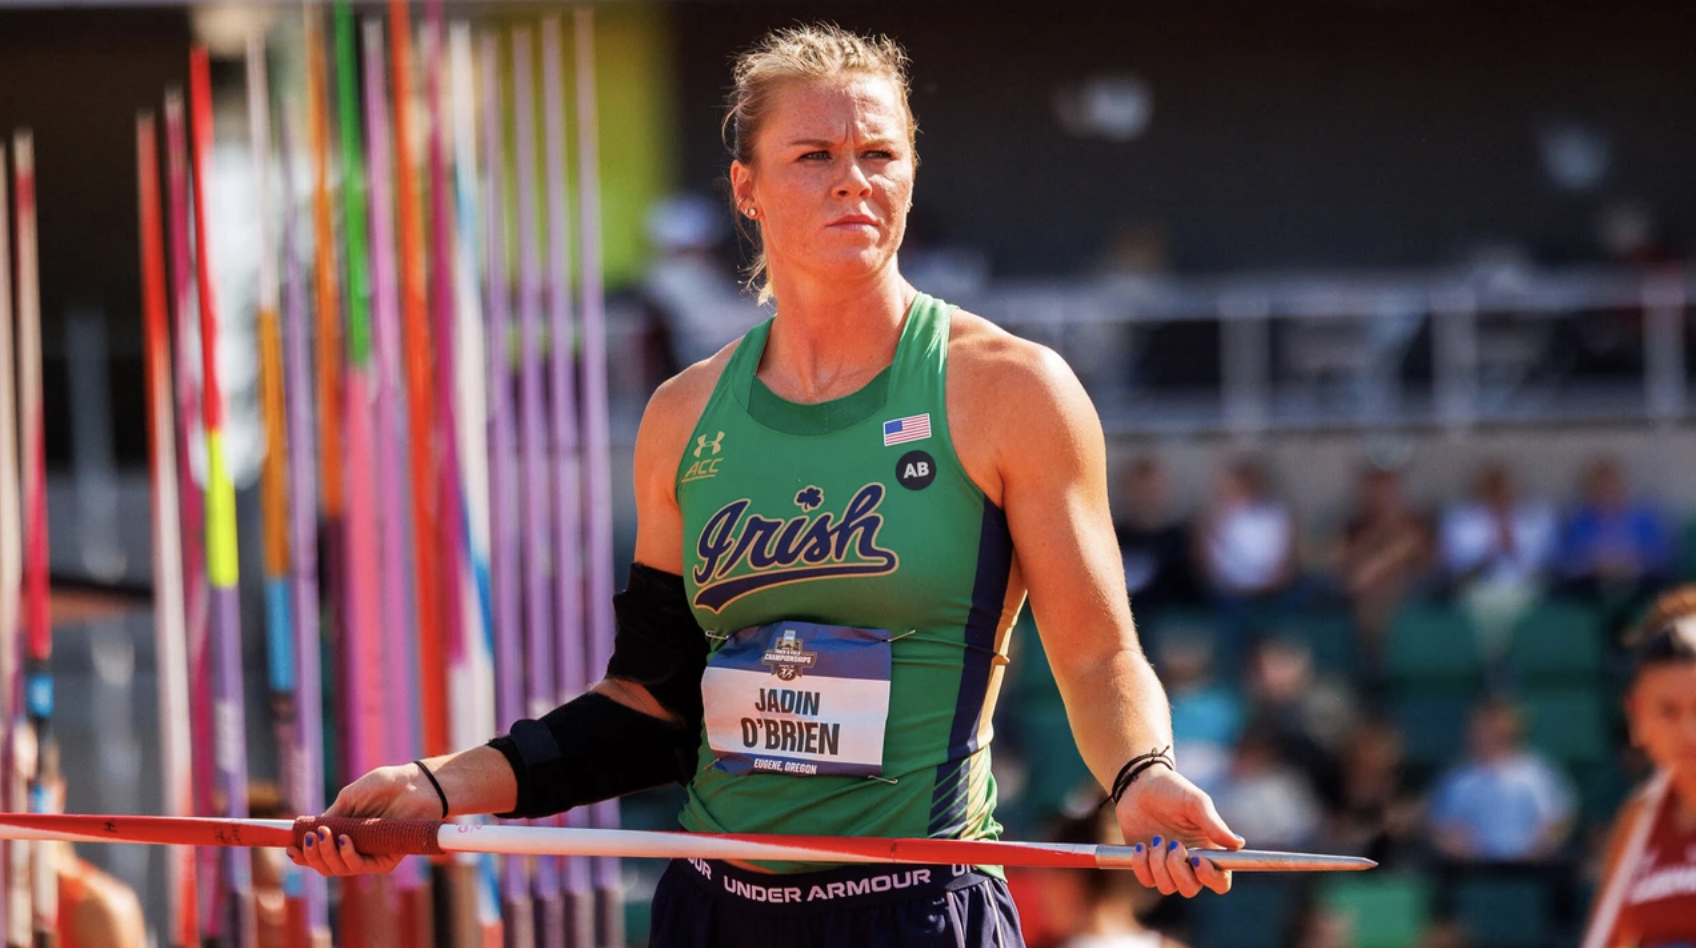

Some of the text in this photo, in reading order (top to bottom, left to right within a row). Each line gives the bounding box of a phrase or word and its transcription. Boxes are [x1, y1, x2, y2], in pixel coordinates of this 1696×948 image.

[684, 457, 724, 479] ACC
[903, 461, 930, 479] AB
[693, 482, 899, 587] Irish
[764, 654, 811, 664] CHAMPIONSHIPS
[754, 688, 820, 716] JADIN
[741, 717, 840, 755] O'BRIEN
[784, 761, 817, 775] OREGON
[723, 868, 931, 903] UNDER ARMOUR
